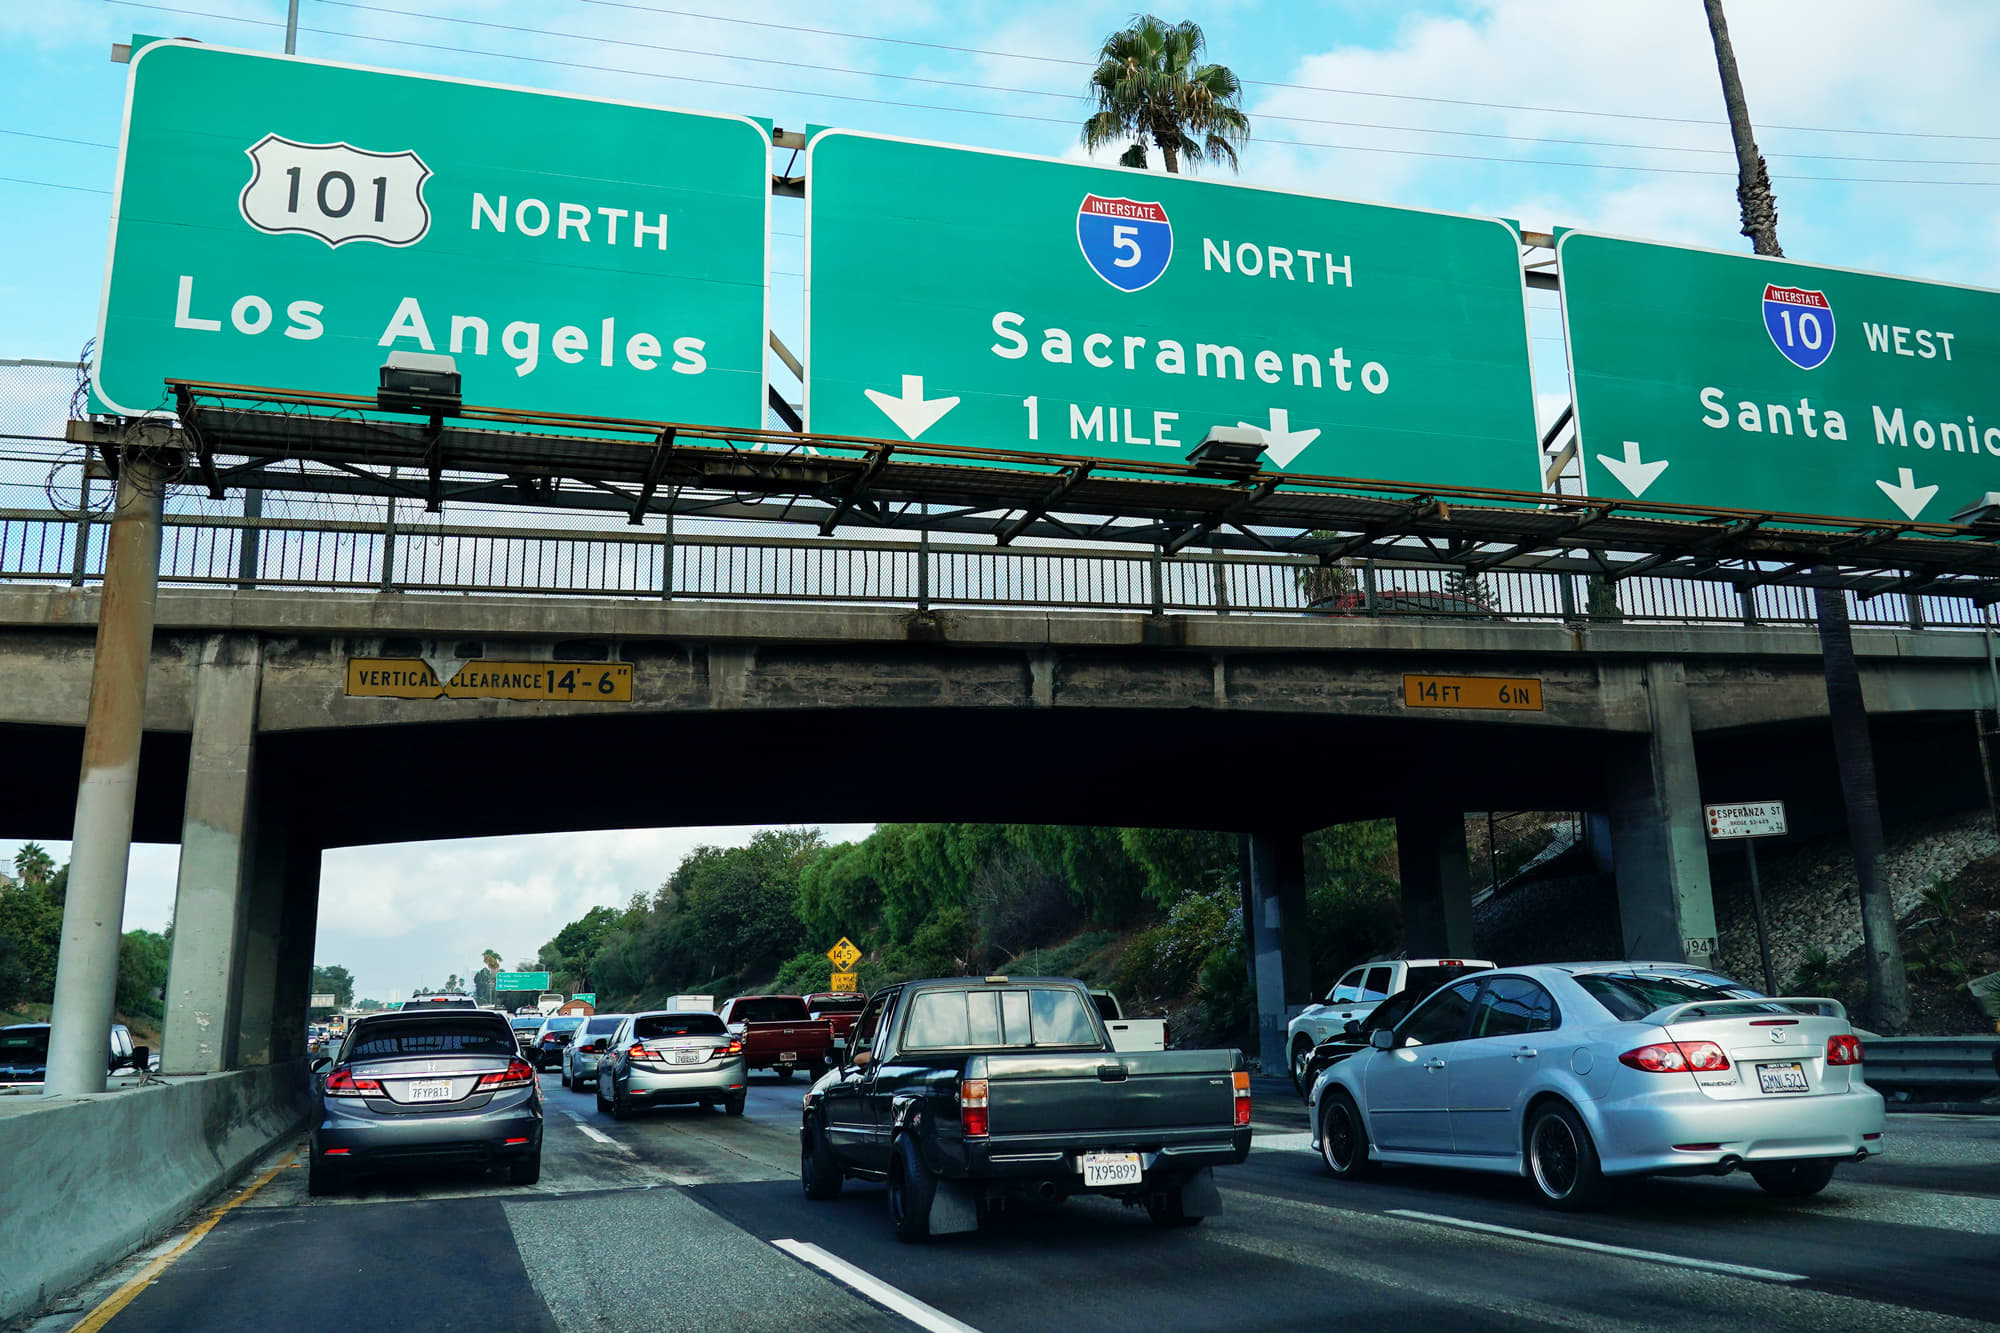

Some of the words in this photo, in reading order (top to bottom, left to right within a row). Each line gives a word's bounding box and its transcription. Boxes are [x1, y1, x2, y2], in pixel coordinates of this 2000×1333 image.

[285, 166, 388, 223] 101
[1091, 200, 1156, 221] INTERSTATE
[471, 192, 668, 251] NORTH
[1112, 226, 1142, 268] 5
[1203, 237, 1353, 287] NORTH
[1771, 290, 1821, 306] INTERSTATE
[174, 275, 324, 341] Los
[378, 297, 708, 377] Angeles
[1779, 310, 1822, 350] 10
[1863, 322, 1954, 361] WEST
[991, 311, 1389, 394] Sacramento
[1023, 396, 1038, 439] 1
[1069, 404, 1181, 448] MILE
[1700, 387, 1847, 441] Santa
[360, 671, 438, 686] VERTICAL
[450, 674, 542, 689] CLEARANCE
[1717, 807, 1765, 818] ESPERANZA
[1771, 807, 1780, 815] ST
[413, 1087, 448, 1097] 7FYP813
[1088, 1164, 1136, 1180] 7X95899
